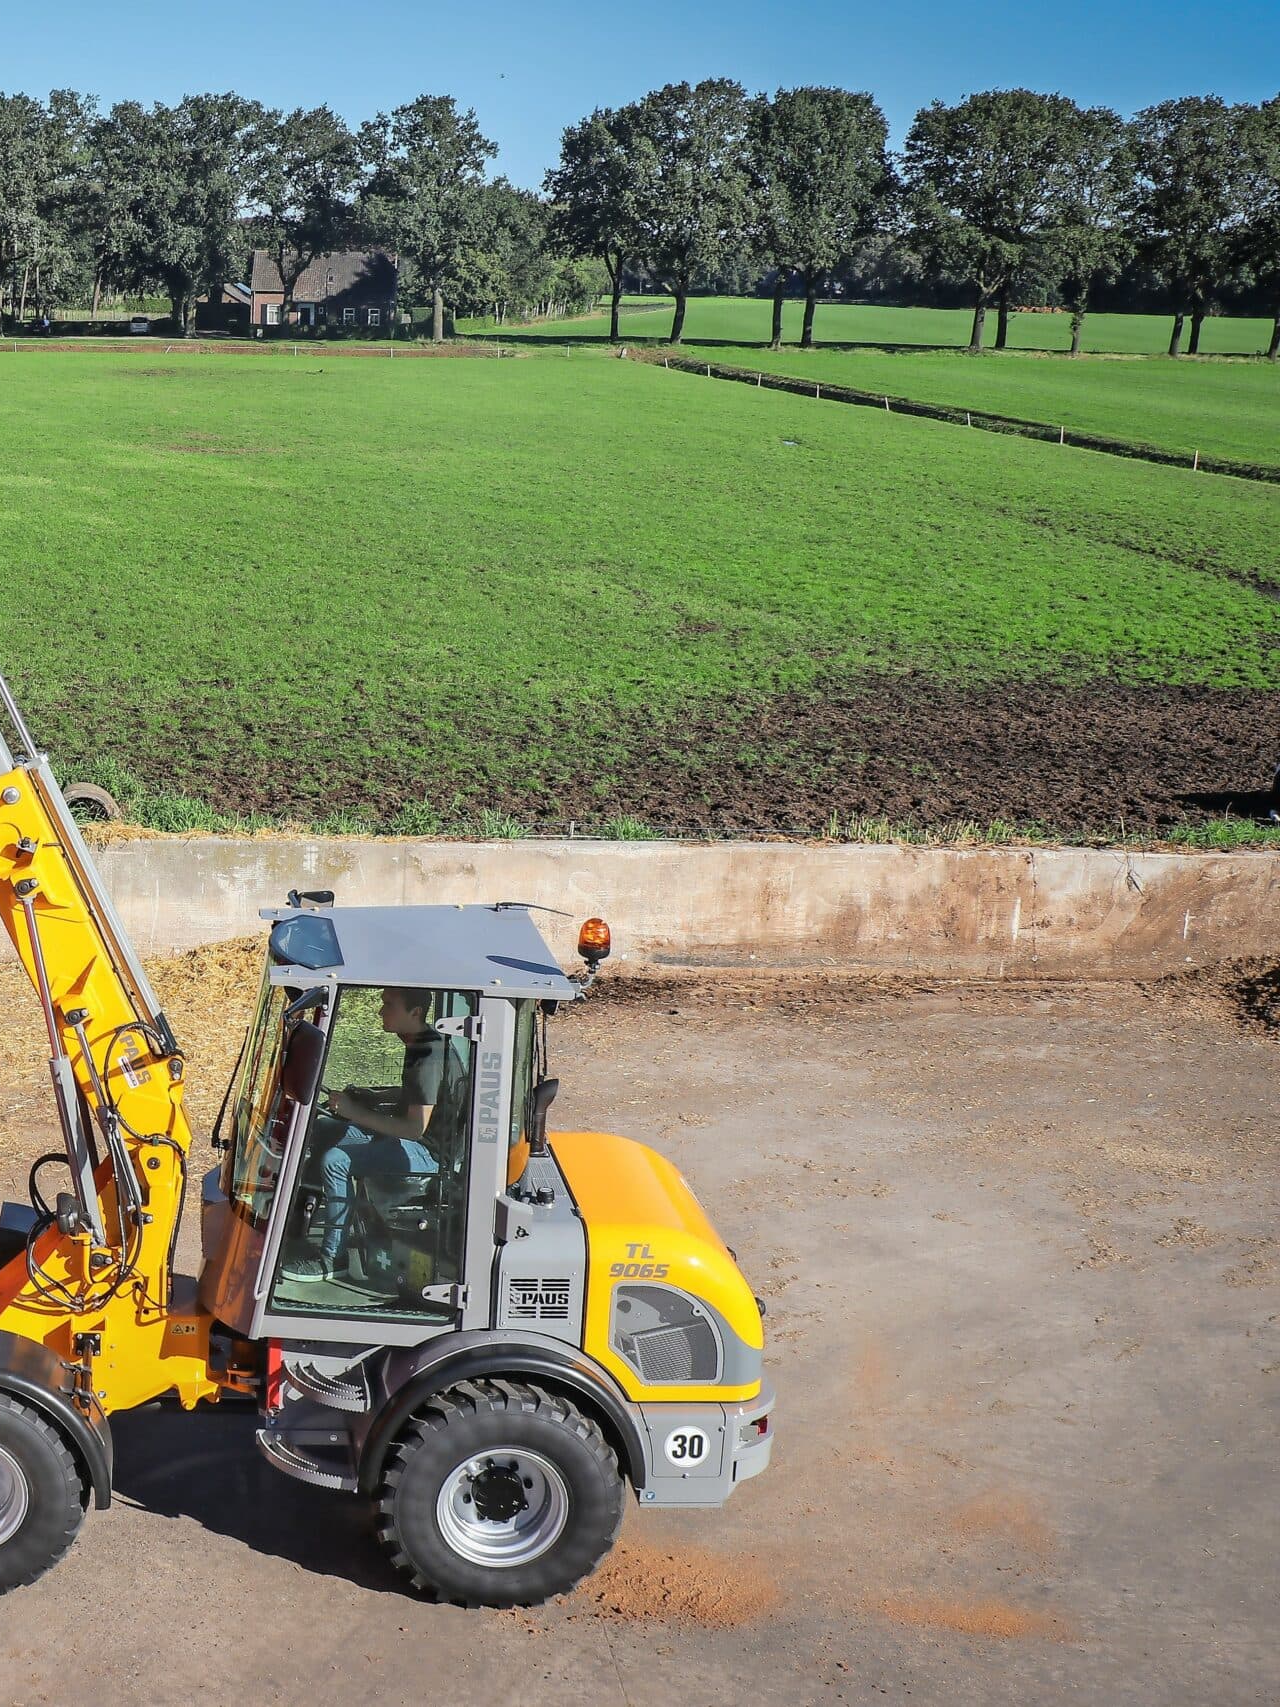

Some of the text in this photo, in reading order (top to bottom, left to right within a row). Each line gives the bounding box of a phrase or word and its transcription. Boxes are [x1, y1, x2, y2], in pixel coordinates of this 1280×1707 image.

[479, 1052, 502, 1124] PAUS
[625, 1243, 655, 1259] TL
[609, 1263, 670, 1278] 9065
[521, 1293, 569, 1305] PAUS
[672, 1434, 704, 1459] 30
